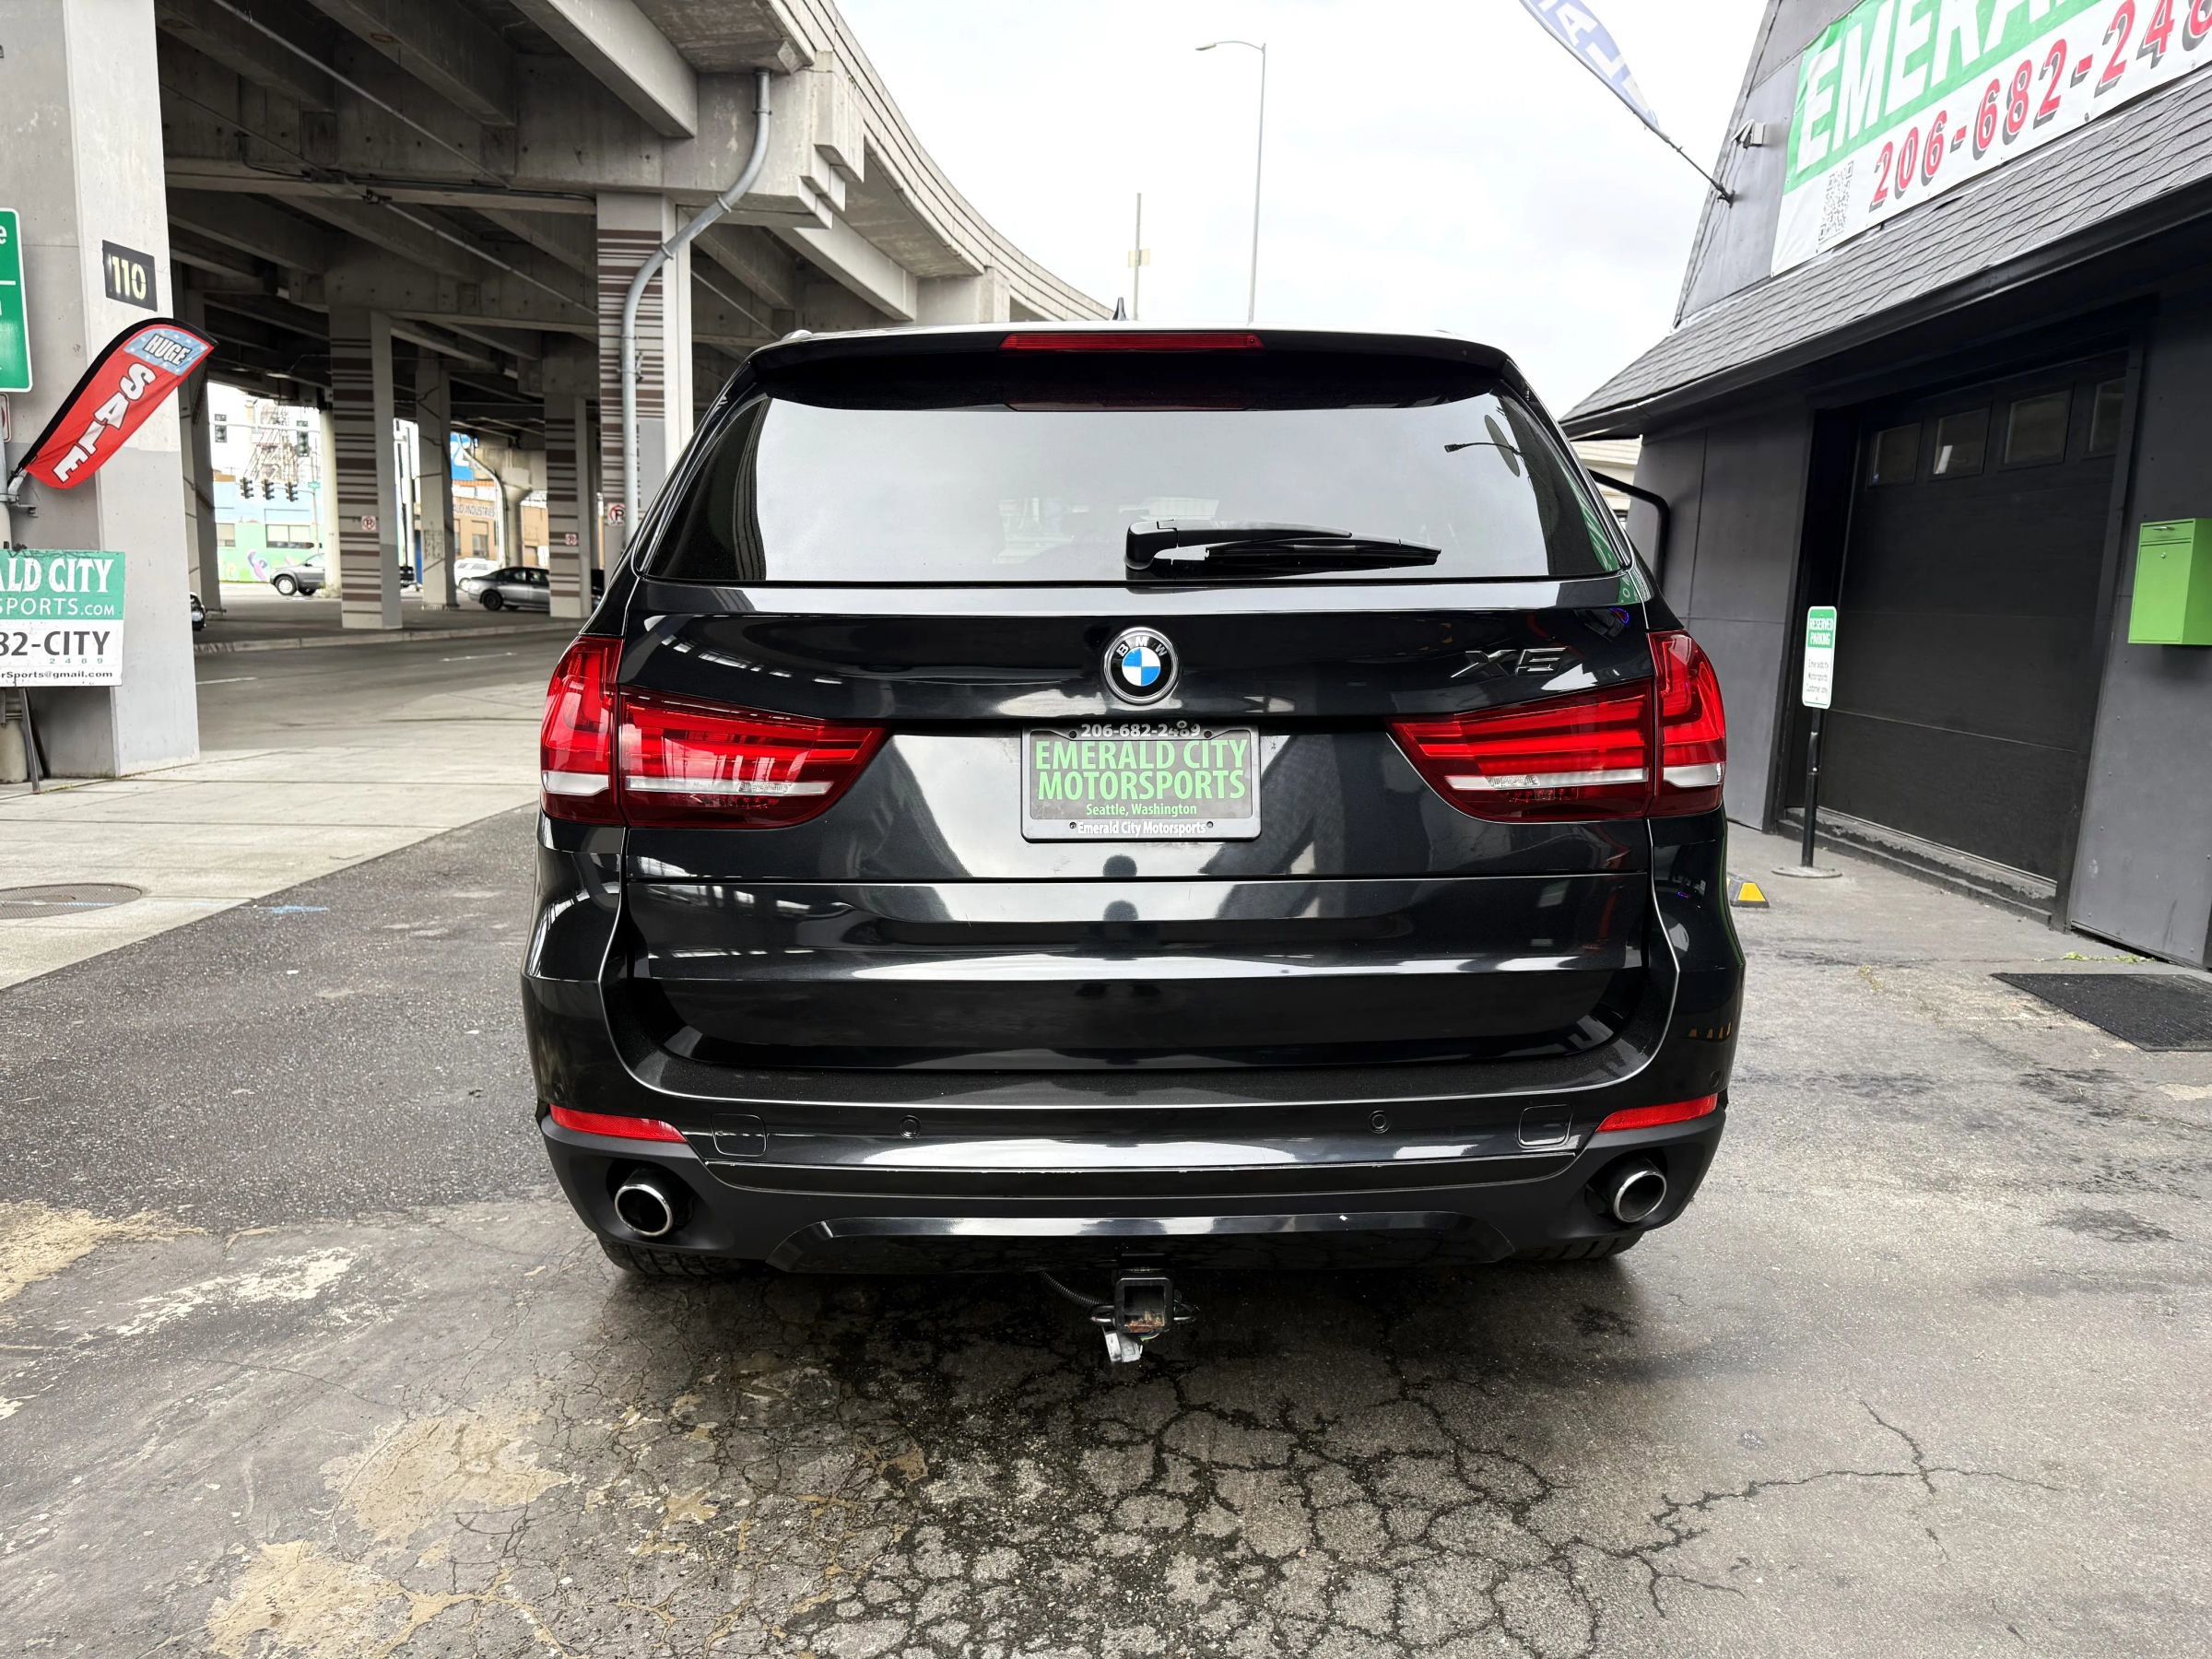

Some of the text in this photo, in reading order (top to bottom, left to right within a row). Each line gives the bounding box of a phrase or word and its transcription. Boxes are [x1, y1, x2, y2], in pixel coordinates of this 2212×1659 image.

[1796, 0, 2069, 174] EMER
[110, 256, 147, 300] 110
[143, 334, 192, 366] HUGE
[52, 362, 157, 483] SALE
[49, 558, 114, 593] CITY
[1116, 636, 1167, 657] BMW
[1080, 721, 1201, 738] 206-682-2489
[1035, 739, 1248, 771] EMERALD CITY
[1038, 770, 1246, 801] MOTORSPORTS
[1086, 803, 1197, 818] Seattle, Washington
[1077, 821, 1206, 838] Emerald City Motorsports
